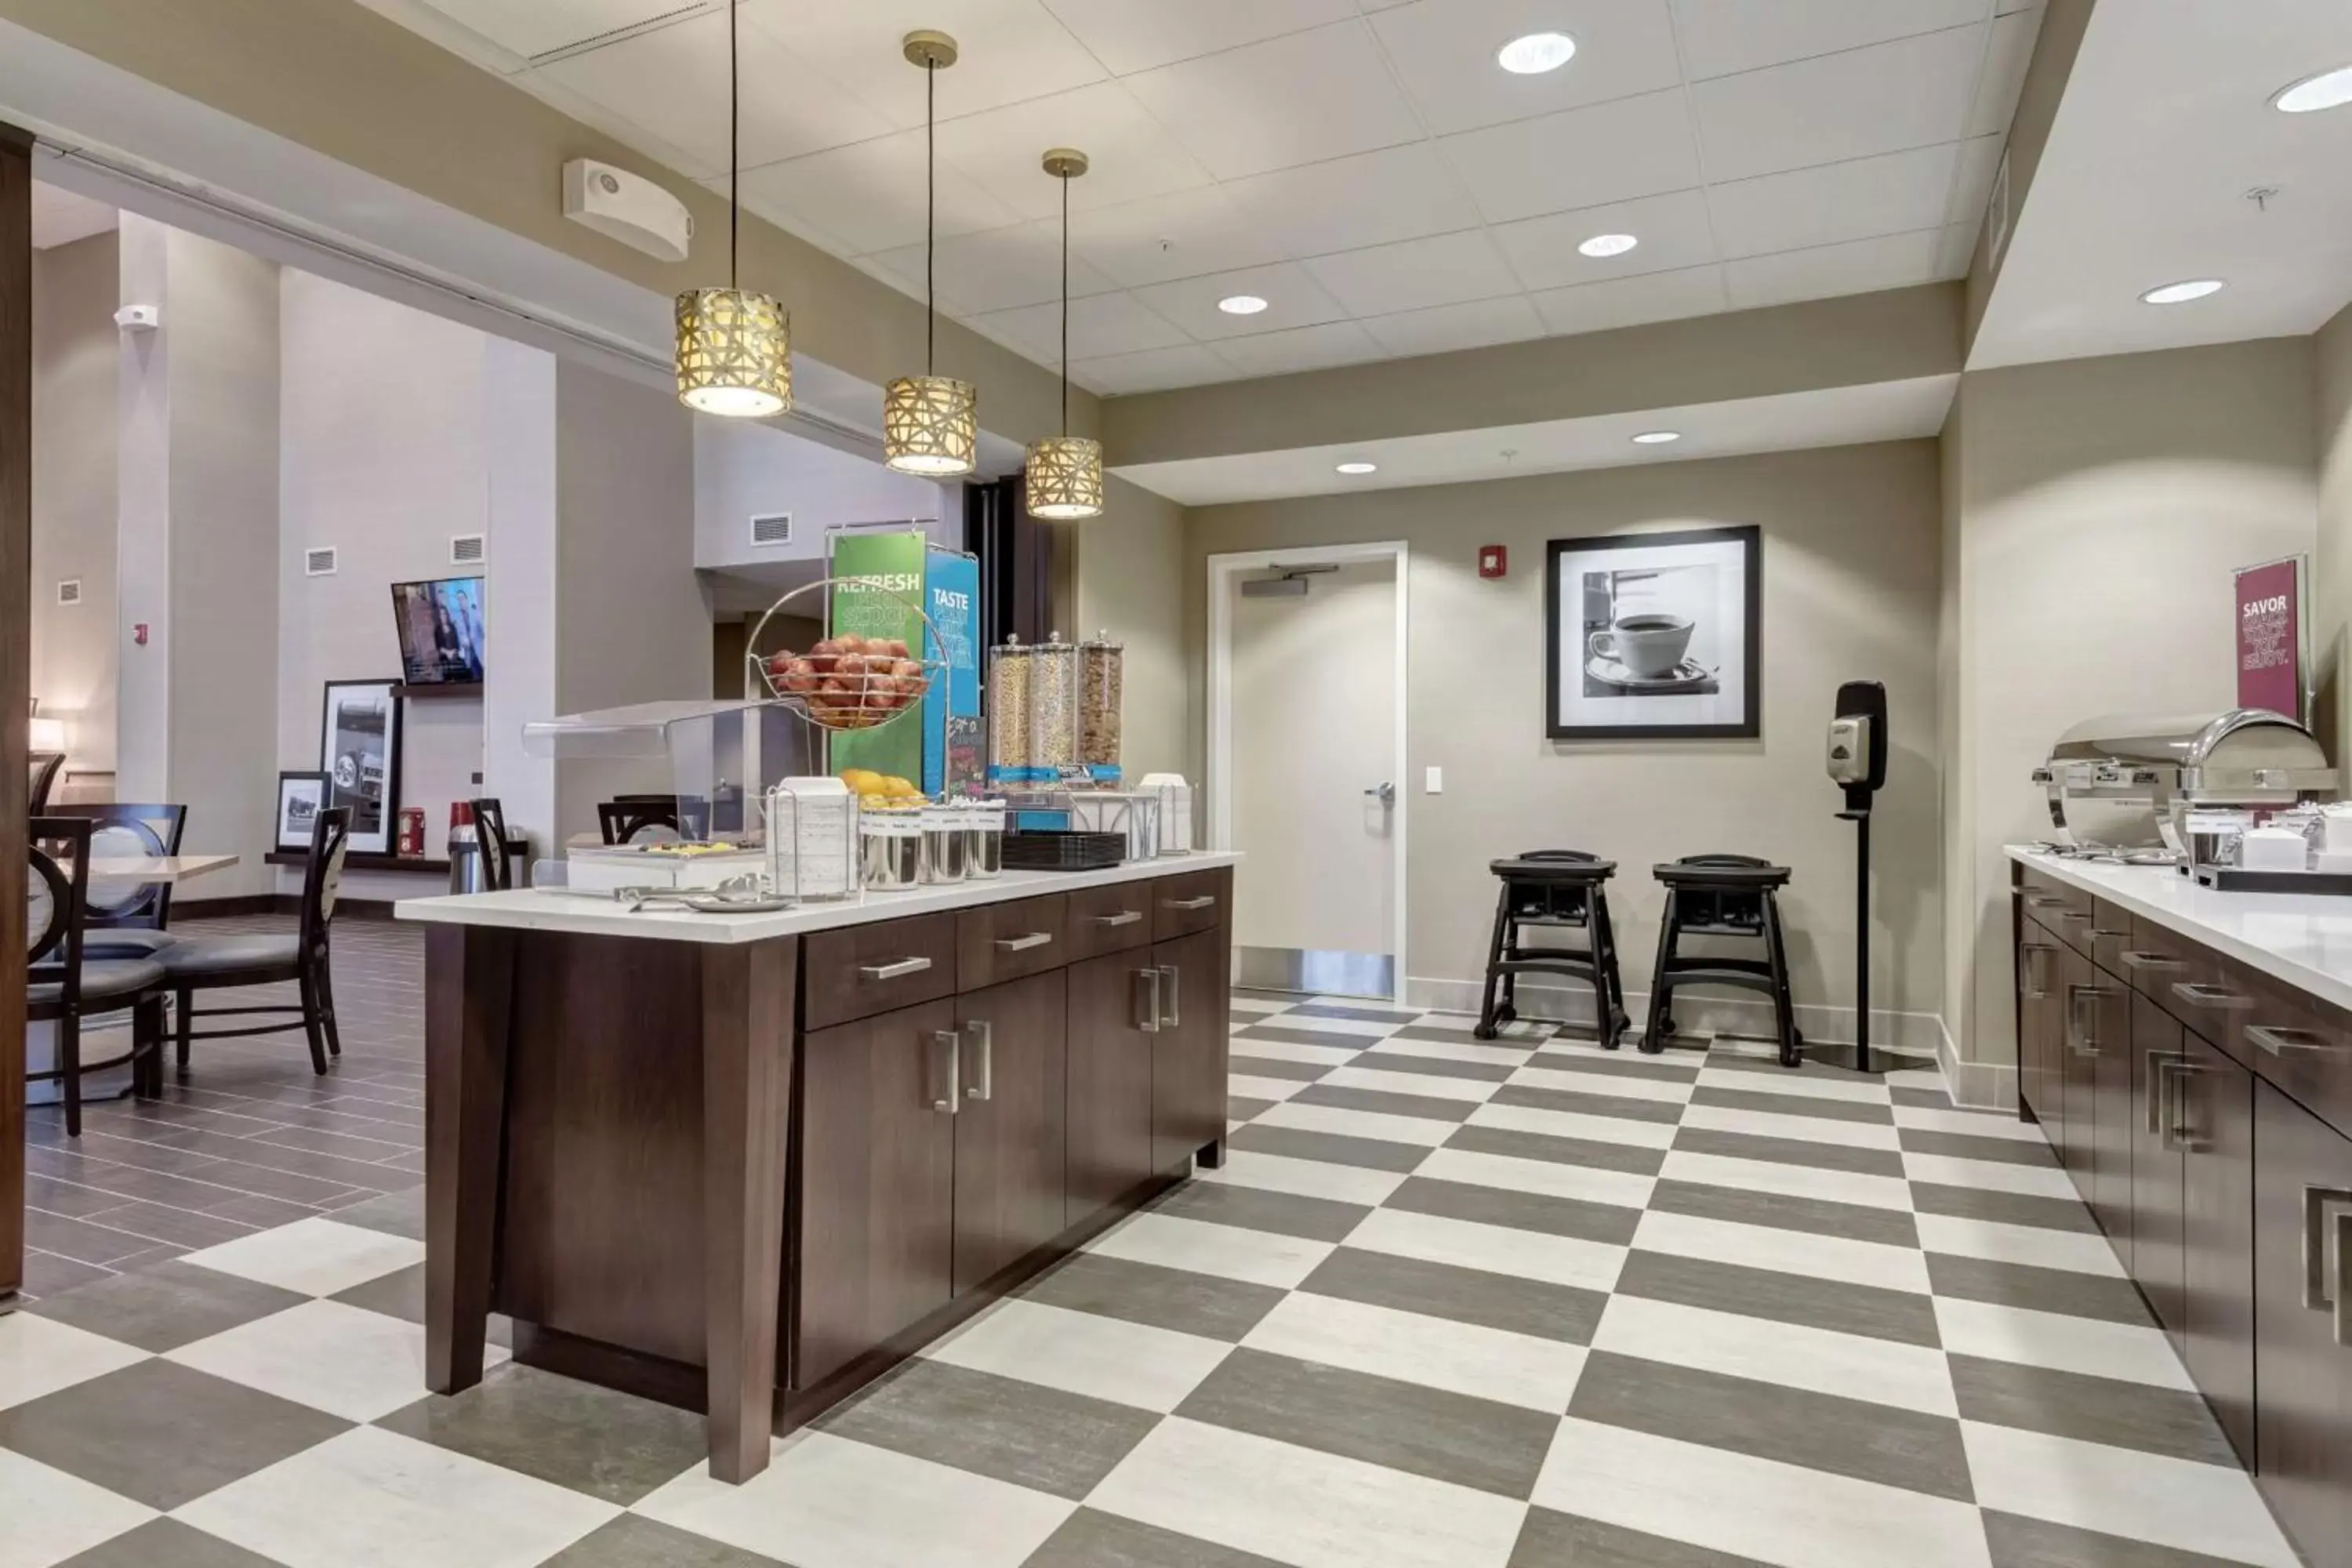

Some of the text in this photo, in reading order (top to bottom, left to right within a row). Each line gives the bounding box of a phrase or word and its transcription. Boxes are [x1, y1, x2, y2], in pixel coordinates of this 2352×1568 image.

[837, 573, 920, 593] REFRESH
[933, 586, 969, 610] TASTE
[2243, 594, 2287, 617] SAVOR
